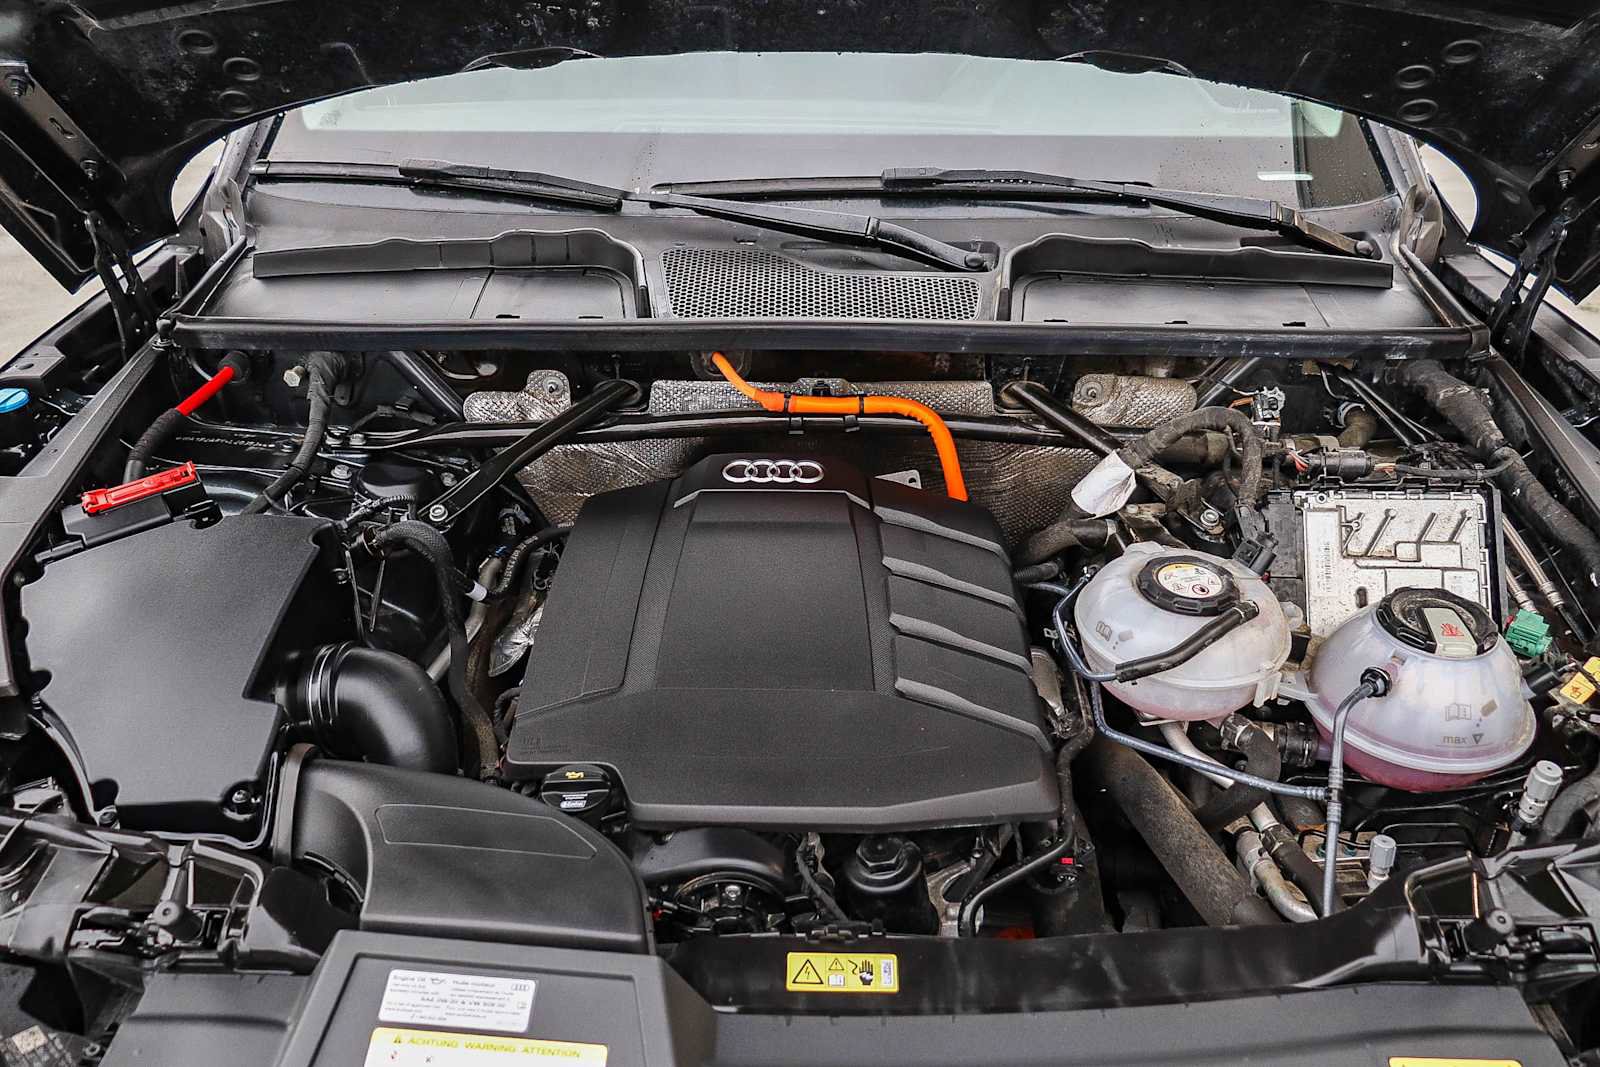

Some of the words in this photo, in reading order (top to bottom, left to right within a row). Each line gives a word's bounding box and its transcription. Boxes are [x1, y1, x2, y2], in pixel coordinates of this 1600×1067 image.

[1443, 735, 1467, 744] max
[409, 1038, 459, 1049] ACHTUNG
[464, 1041, 517, 1053] WARNING
[522, 1046, 581, 1058] ATTENTION
